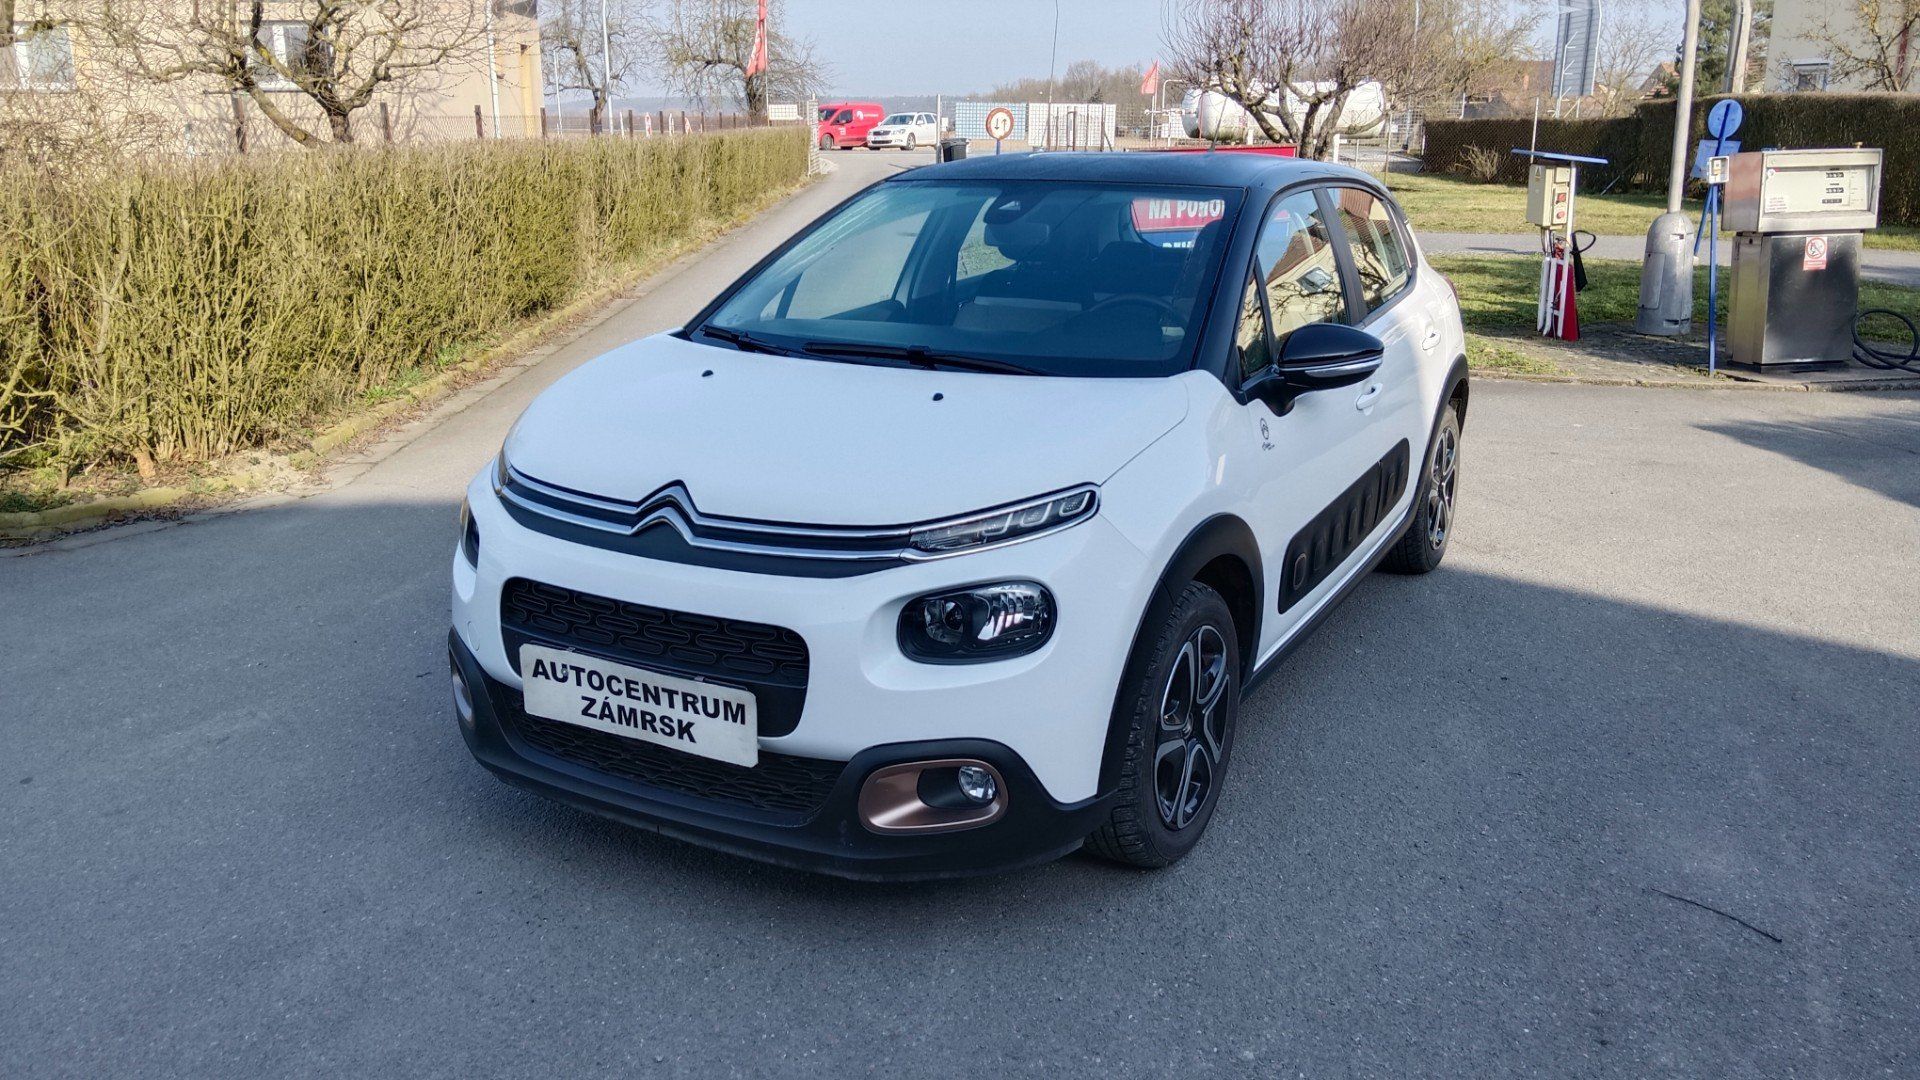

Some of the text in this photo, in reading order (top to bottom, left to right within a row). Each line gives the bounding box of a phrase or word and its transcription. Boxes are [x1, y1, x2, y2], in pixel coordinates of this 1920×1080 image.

[1149, 199, 1171, 219] NA
[532, 659, 746, 725] AUTOCENTRUM
[580, 696, 697, 744] ZÁMRSK
